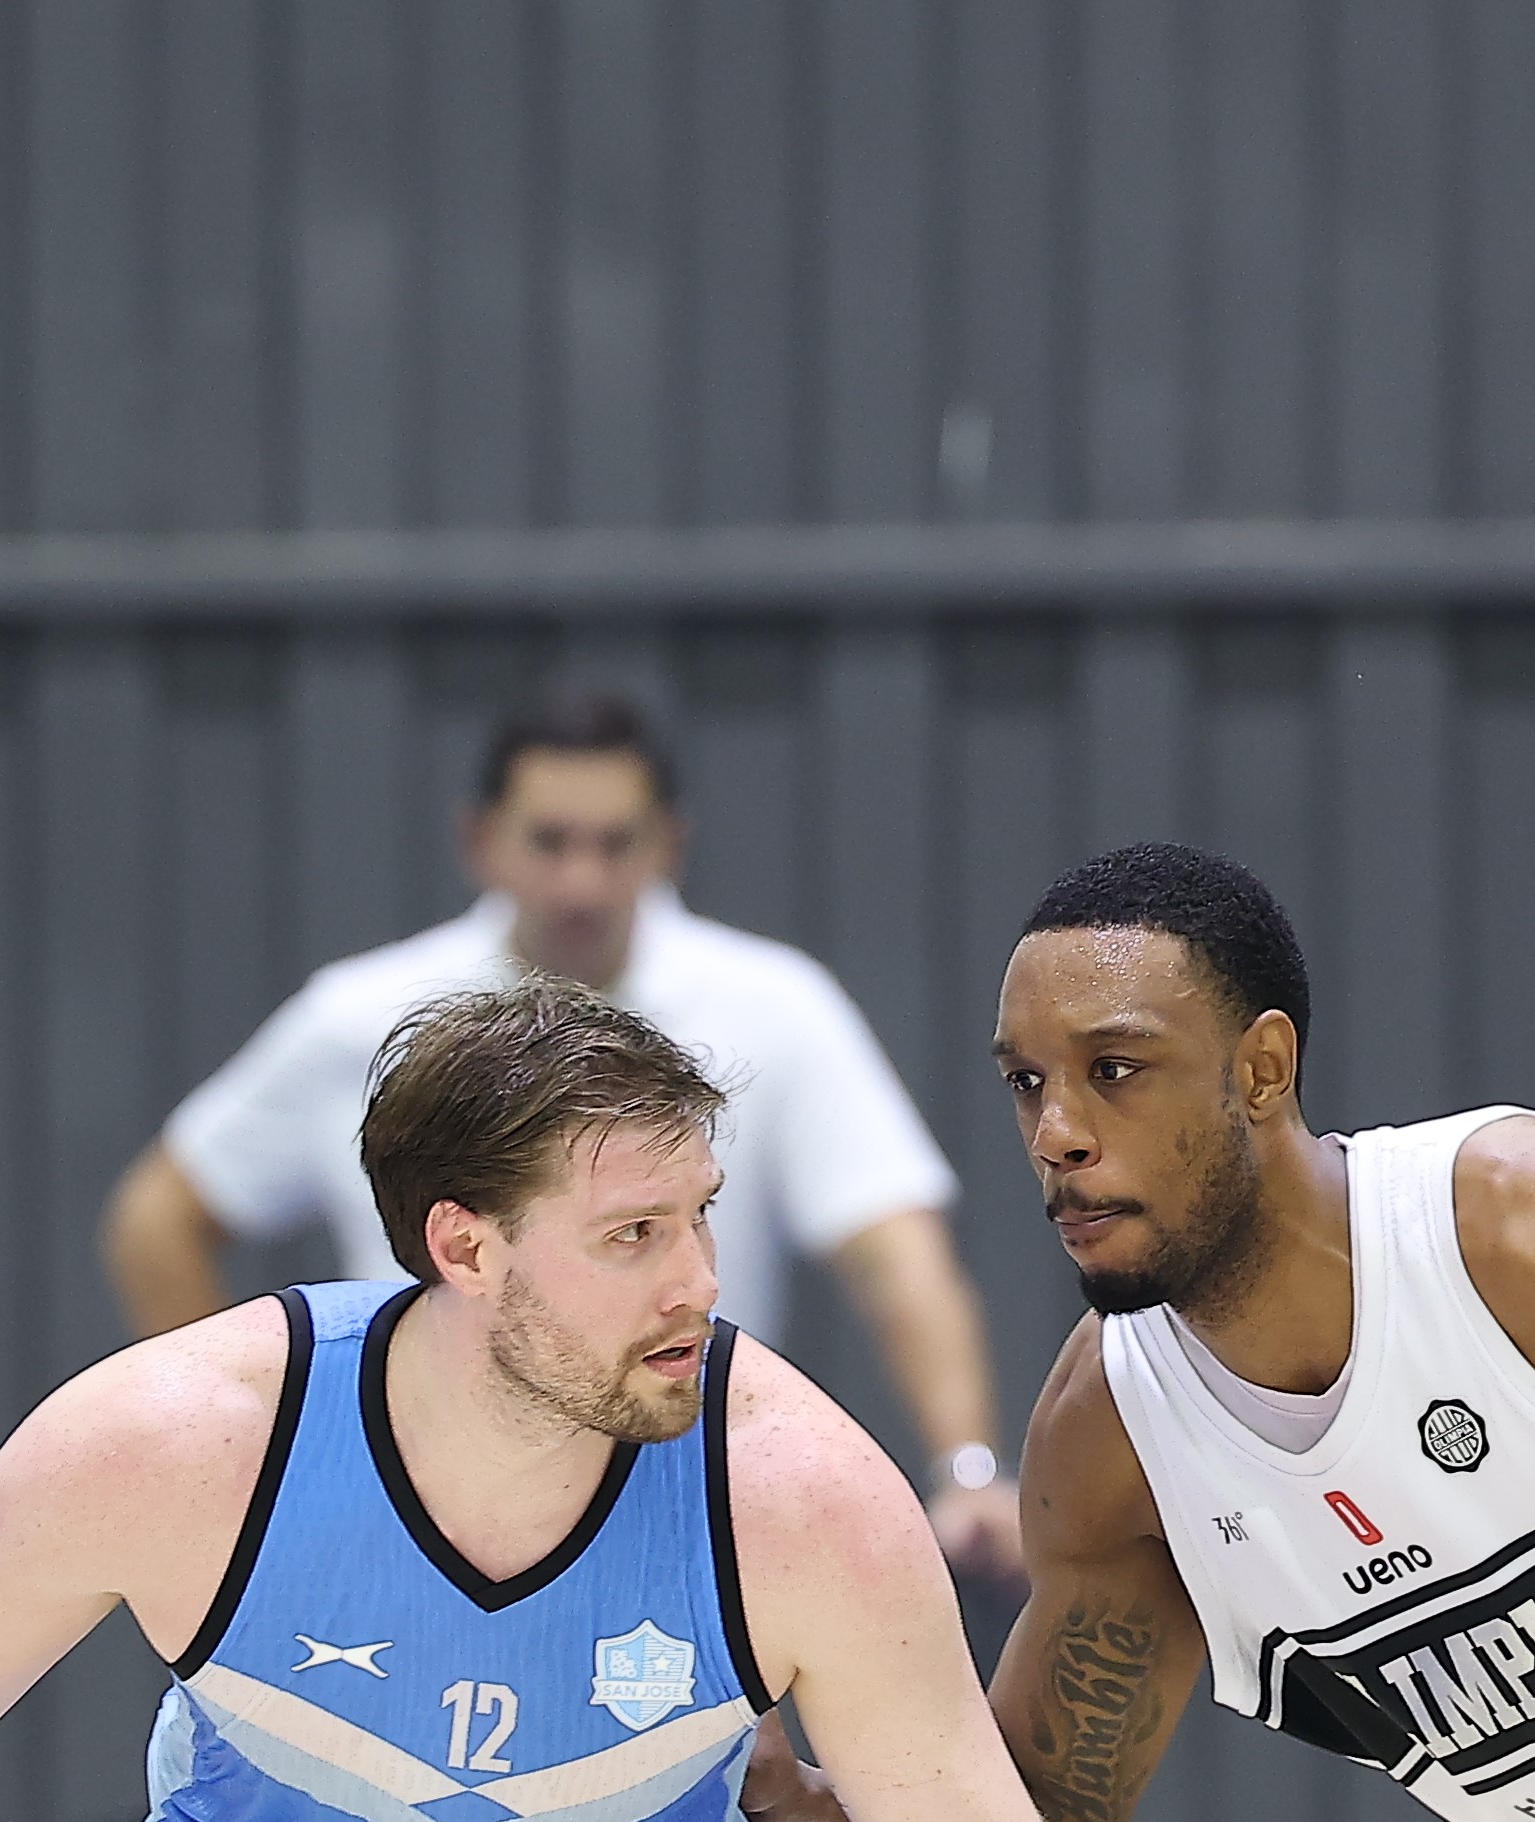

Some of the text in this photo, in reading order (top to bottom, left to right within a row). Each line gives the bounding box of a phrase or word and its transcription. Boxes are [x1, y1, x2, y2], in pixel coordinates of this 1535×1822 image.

[1342, 1544, 1433, 1595] ueno
[602, 1684, 639, 1698] SAN
[439, 1678, 519, 1774] 12
